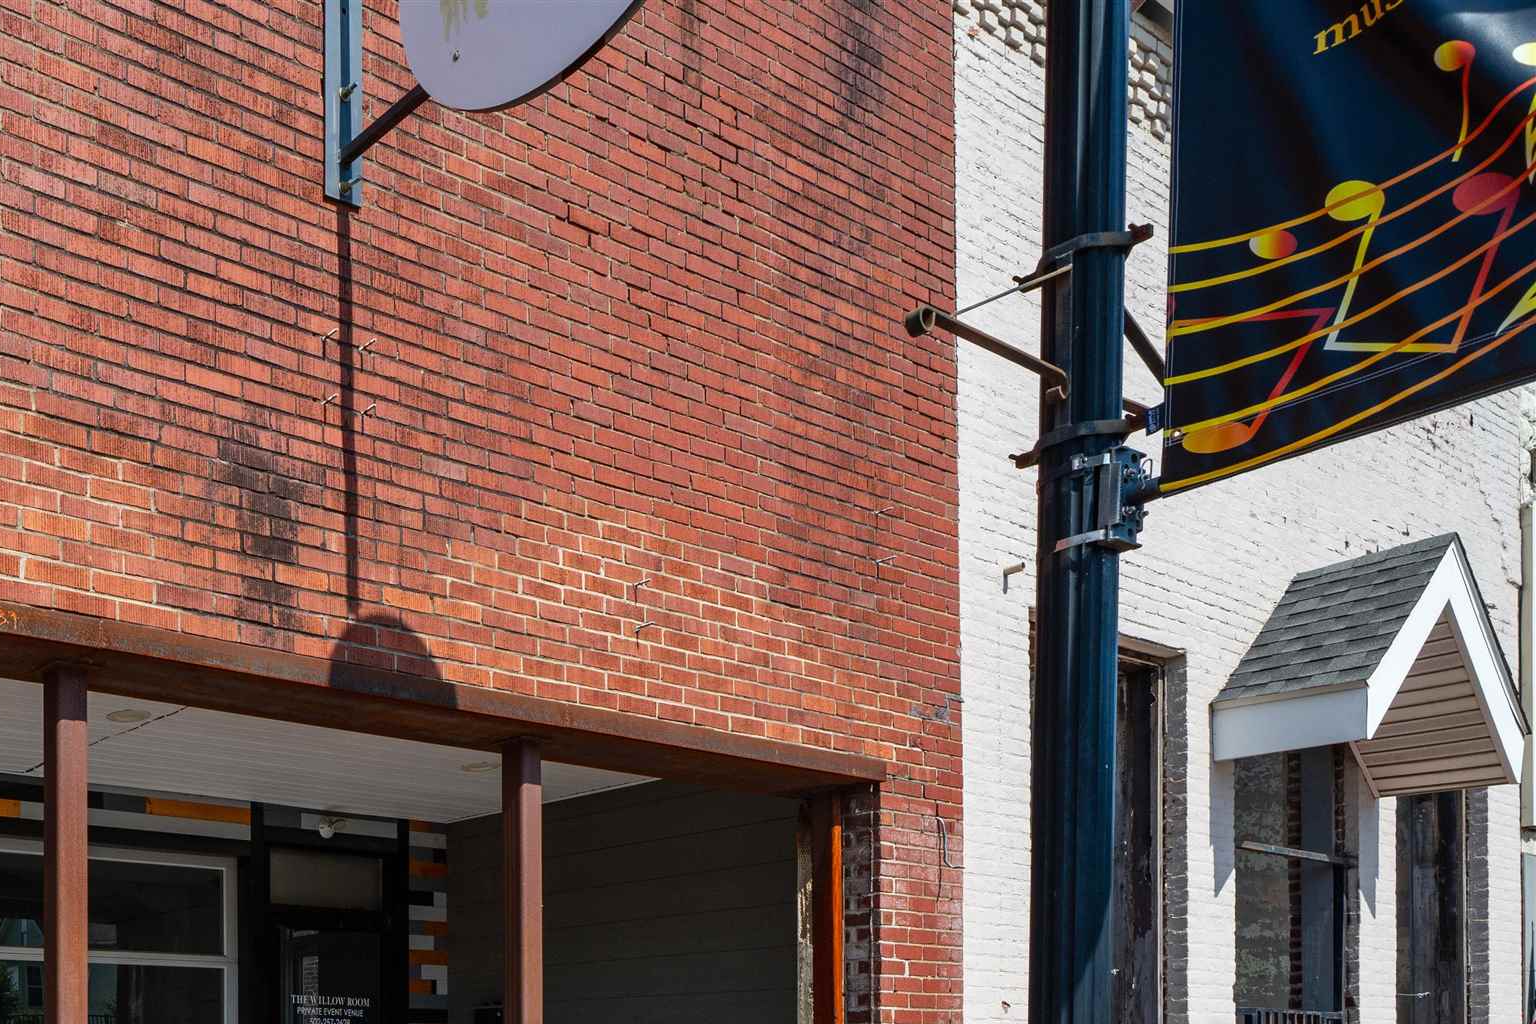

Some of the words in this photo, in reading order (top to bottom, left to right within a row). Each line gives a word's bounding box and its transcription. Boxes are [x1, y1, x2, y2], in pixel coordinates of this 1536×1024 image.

[290, 994, 309, 1004] THE
[310, 995, 346, 1006] WILLOW
[347, 996, 370, 1007] ROOM
[296, 1006, 322, 1015] PRIVATE
[323, 1007, 343, 1016] EVENT
[344, 1008, 364, 1017] VENUE
